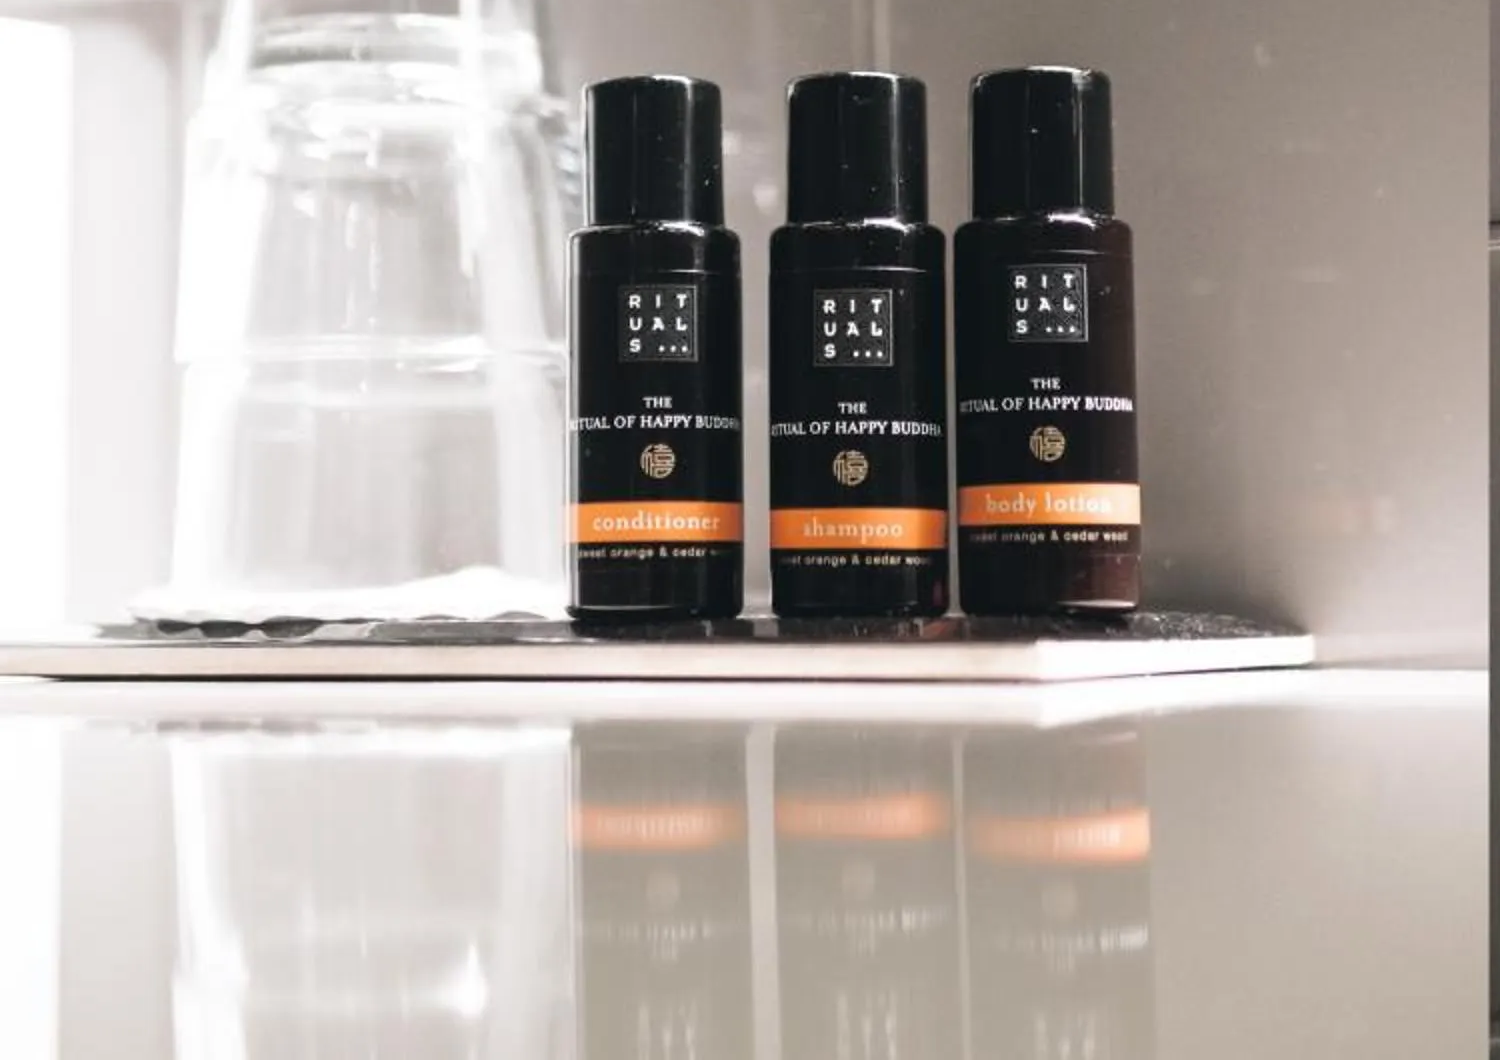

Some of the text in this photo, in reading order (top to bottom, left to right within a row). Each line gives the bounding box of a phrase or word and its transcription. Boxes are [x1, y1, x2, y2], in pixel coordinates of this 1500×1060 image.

[1031, 378, 1061, 390] THE
[643, 396, 672, 408] THE
[838, 402, 867, 414] THE
[1002, 396, 1024, 411] OF
[1028, 396, 1081, 411] HAPPY
[614, 416, 635, 428] OF
[640, 415, 692, 429] HAPPY
[809, 422, 830, 435] OF
[835, 420, 888, 435] HAPPY
[986, 491, 1113, 519] body lotion
[593, 511, 720, 531] conditioner
[803, 517, 904, 543] shampoo
[1001, 531, 1045, 543] orange
[1050, 530, 1060, 541] &
[1063, 531, 1100, 542] cedar
[610, 547, 654, 560] orange
[659, 546, 669, 557] &
[672, 547, 706, 557] cedar
[804, 554, 847, 567] orange
[851, 553, 860, 565] &
[865, 554, 901, 566] cedar
